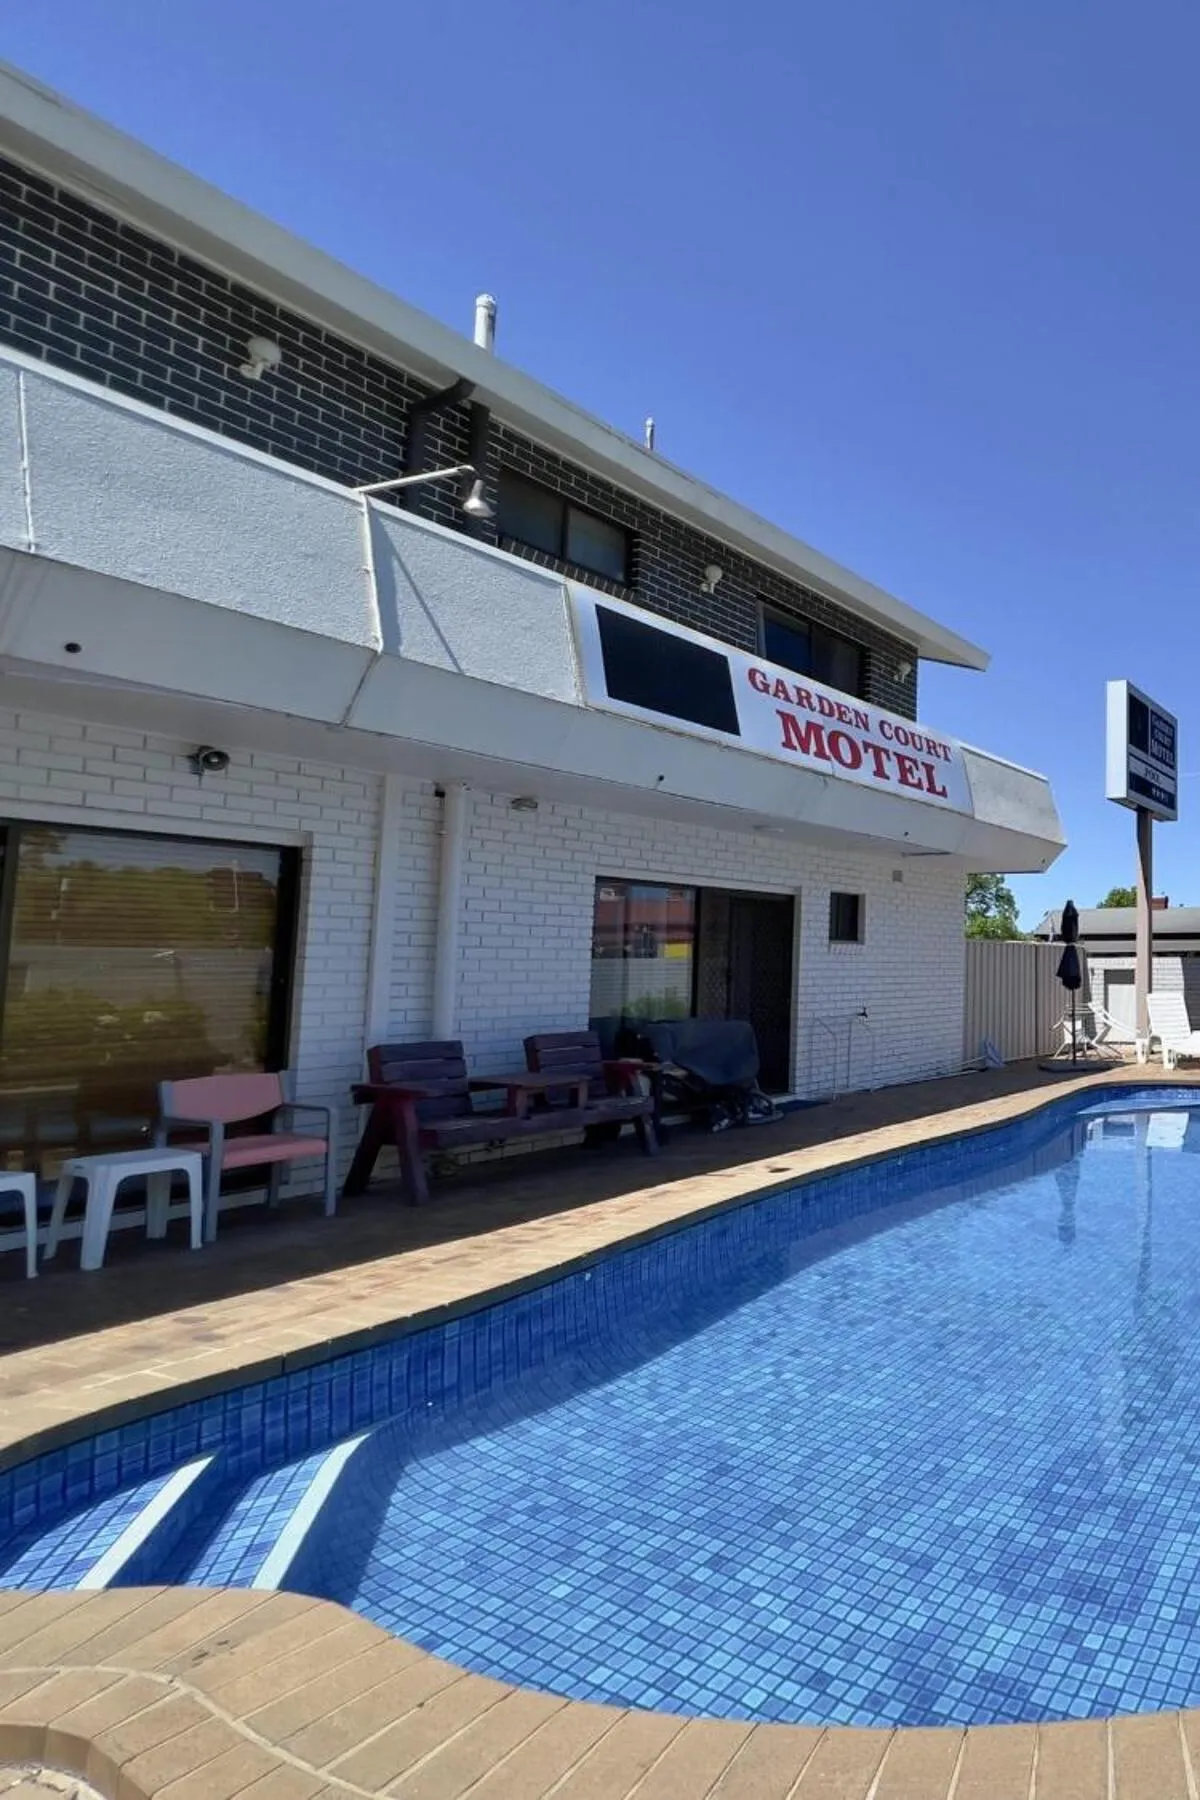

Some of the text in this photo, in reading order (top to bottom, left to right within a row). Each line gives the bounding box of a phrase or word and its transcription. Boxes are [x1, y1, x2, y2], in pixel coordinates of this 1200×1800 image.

[747, 667, 952, 763] GARDEN COURT
[775, 709, 949, 798] MOTEL
